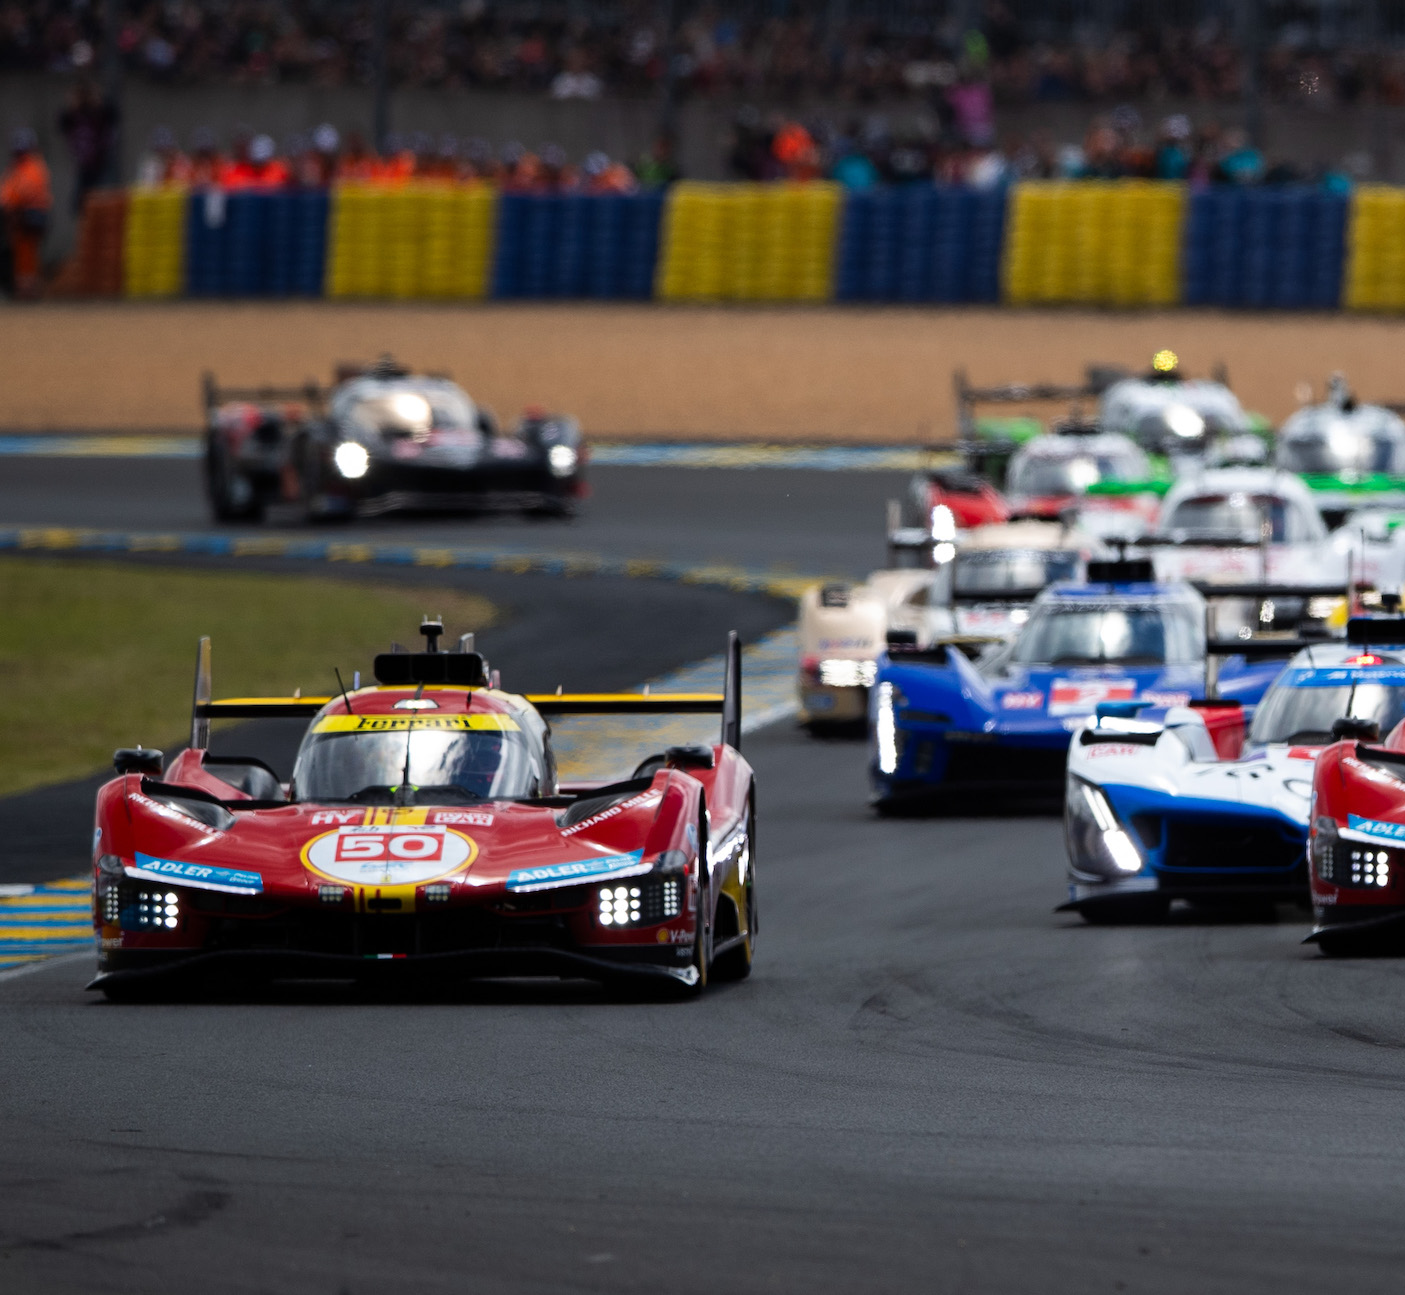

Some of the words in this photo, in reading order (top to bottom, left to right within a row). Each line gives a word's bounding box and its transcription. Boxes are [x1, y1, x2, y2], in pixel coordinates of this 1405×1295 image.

[354, 717, 473, 730] Ferrari
[311, 812, 353, 825] HY
[561, 807, 622, 838] RICHARD
[623, 788, 663, 810] MILLE
[340, 835, 439, 858] 50
[142, 860, 213, 878] ADLER
[517, 863, 588, 882] ADLER
